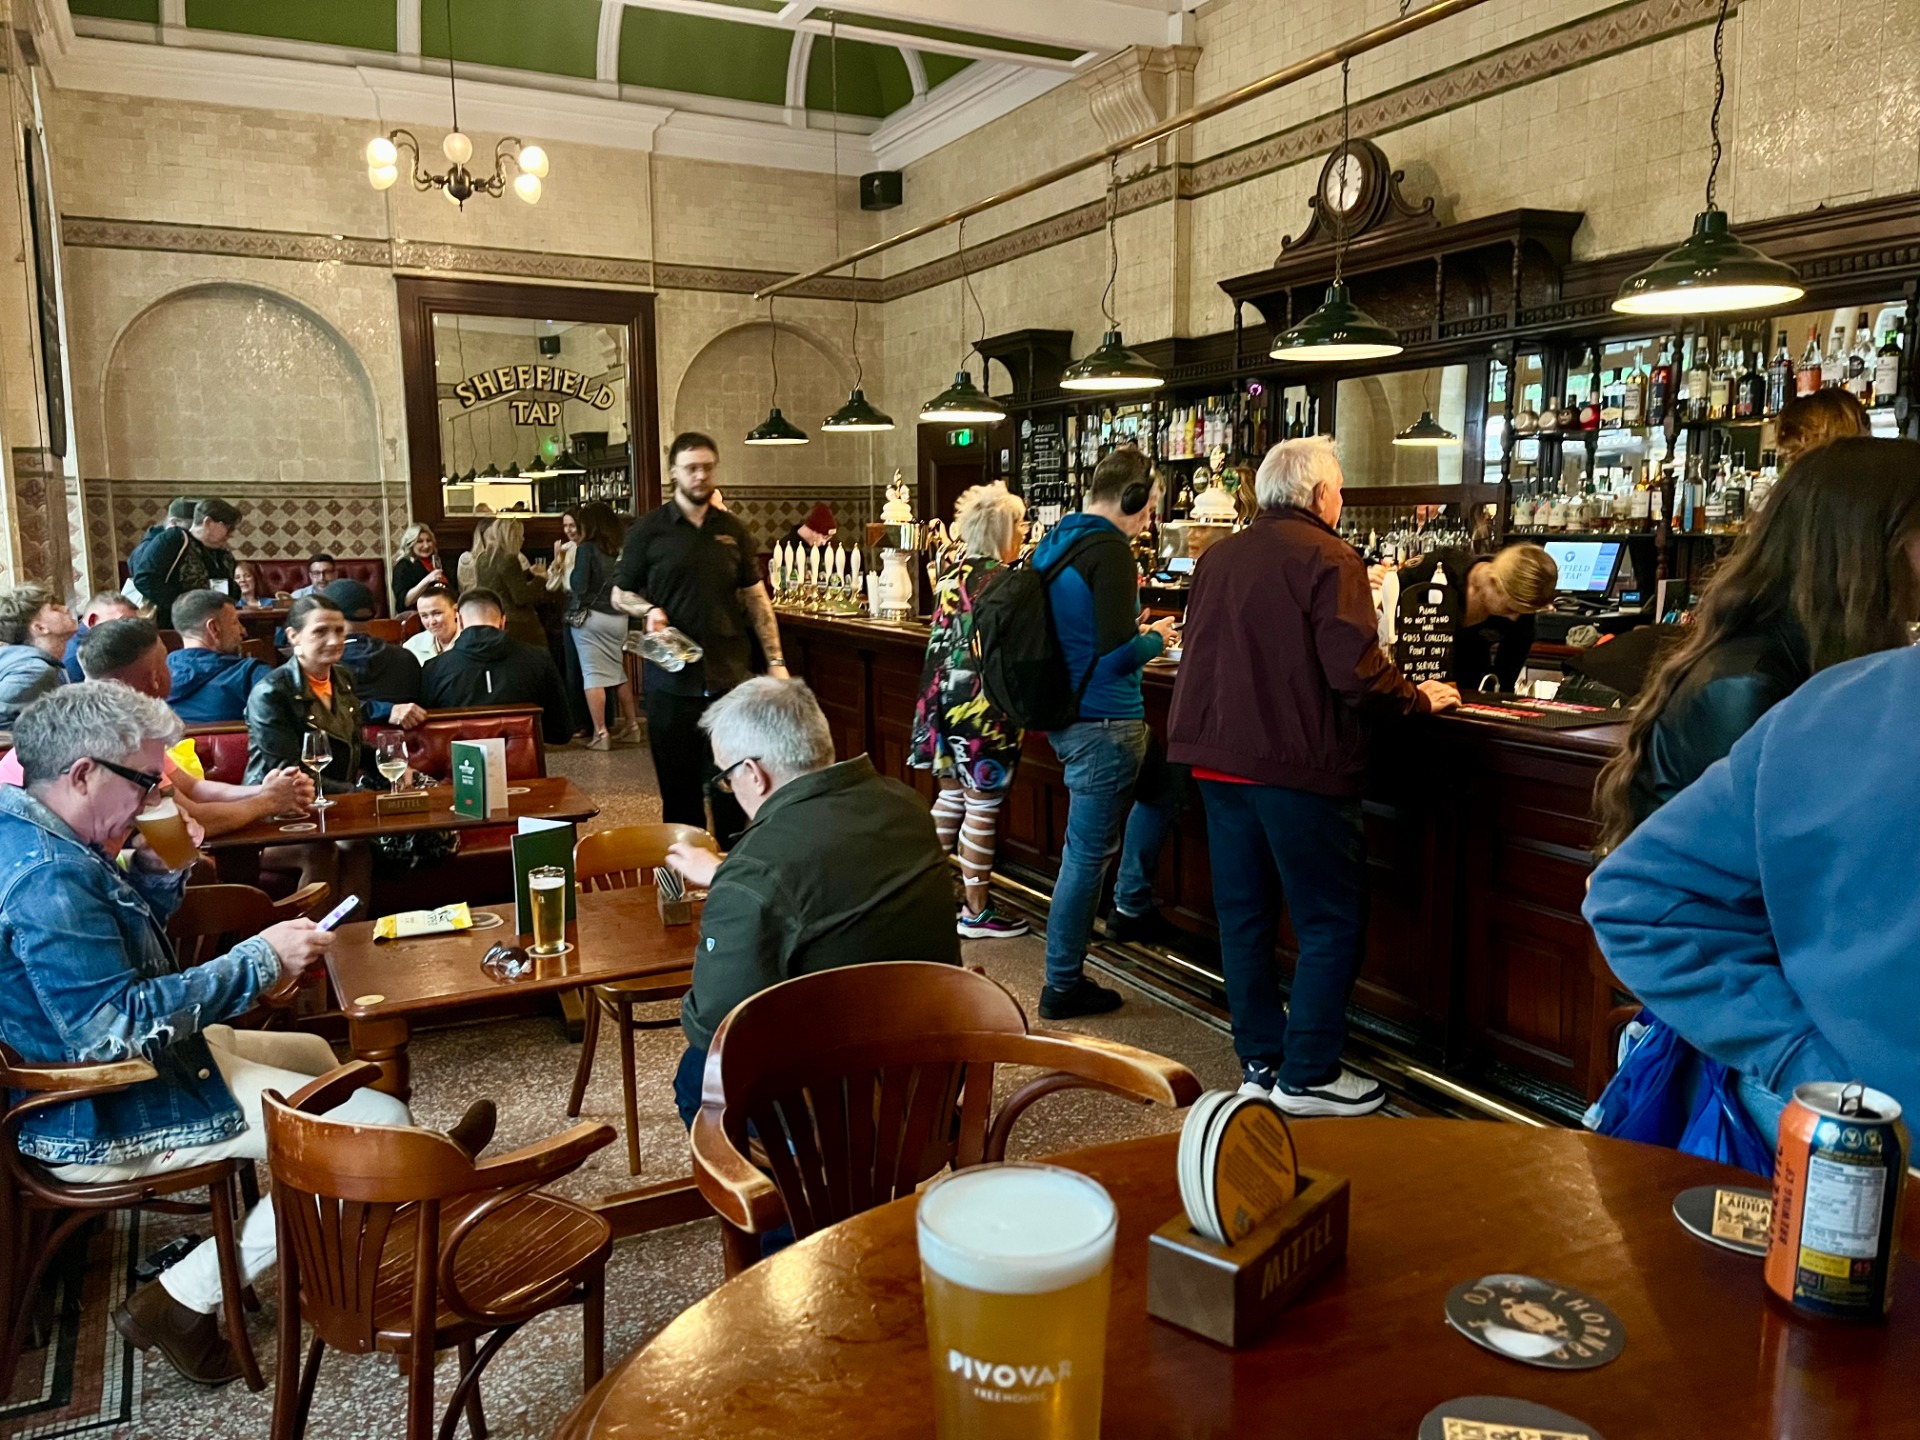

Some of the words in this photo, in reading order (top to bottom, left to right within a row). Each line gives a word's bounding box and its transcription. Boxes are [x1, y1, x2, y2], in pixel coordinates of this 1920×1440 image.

[453, 364, 616, 411] SHEFFIELD
[510, 400, 562, 427] TAP
[1403, 616, 1413, 624] DO
[1414, 616, 1426, 625] NOT
[1430, 615, 1450, 624] STAND
[1409, 644, 1426, 656] POINT
[1404, 662, 1413, 671] NO
[1416, 660, 1440, 671] SERVICE
[1411, 672, 1426, 681] THIS
[1718, 1194, 1771, 1215] LAIDBA
[1780, 1187, 1793, 1246] BREWING
[1260, 1211, 1333, 1301] MITTEL
[947, 1348, 1073, 1389] PIVOVAR
